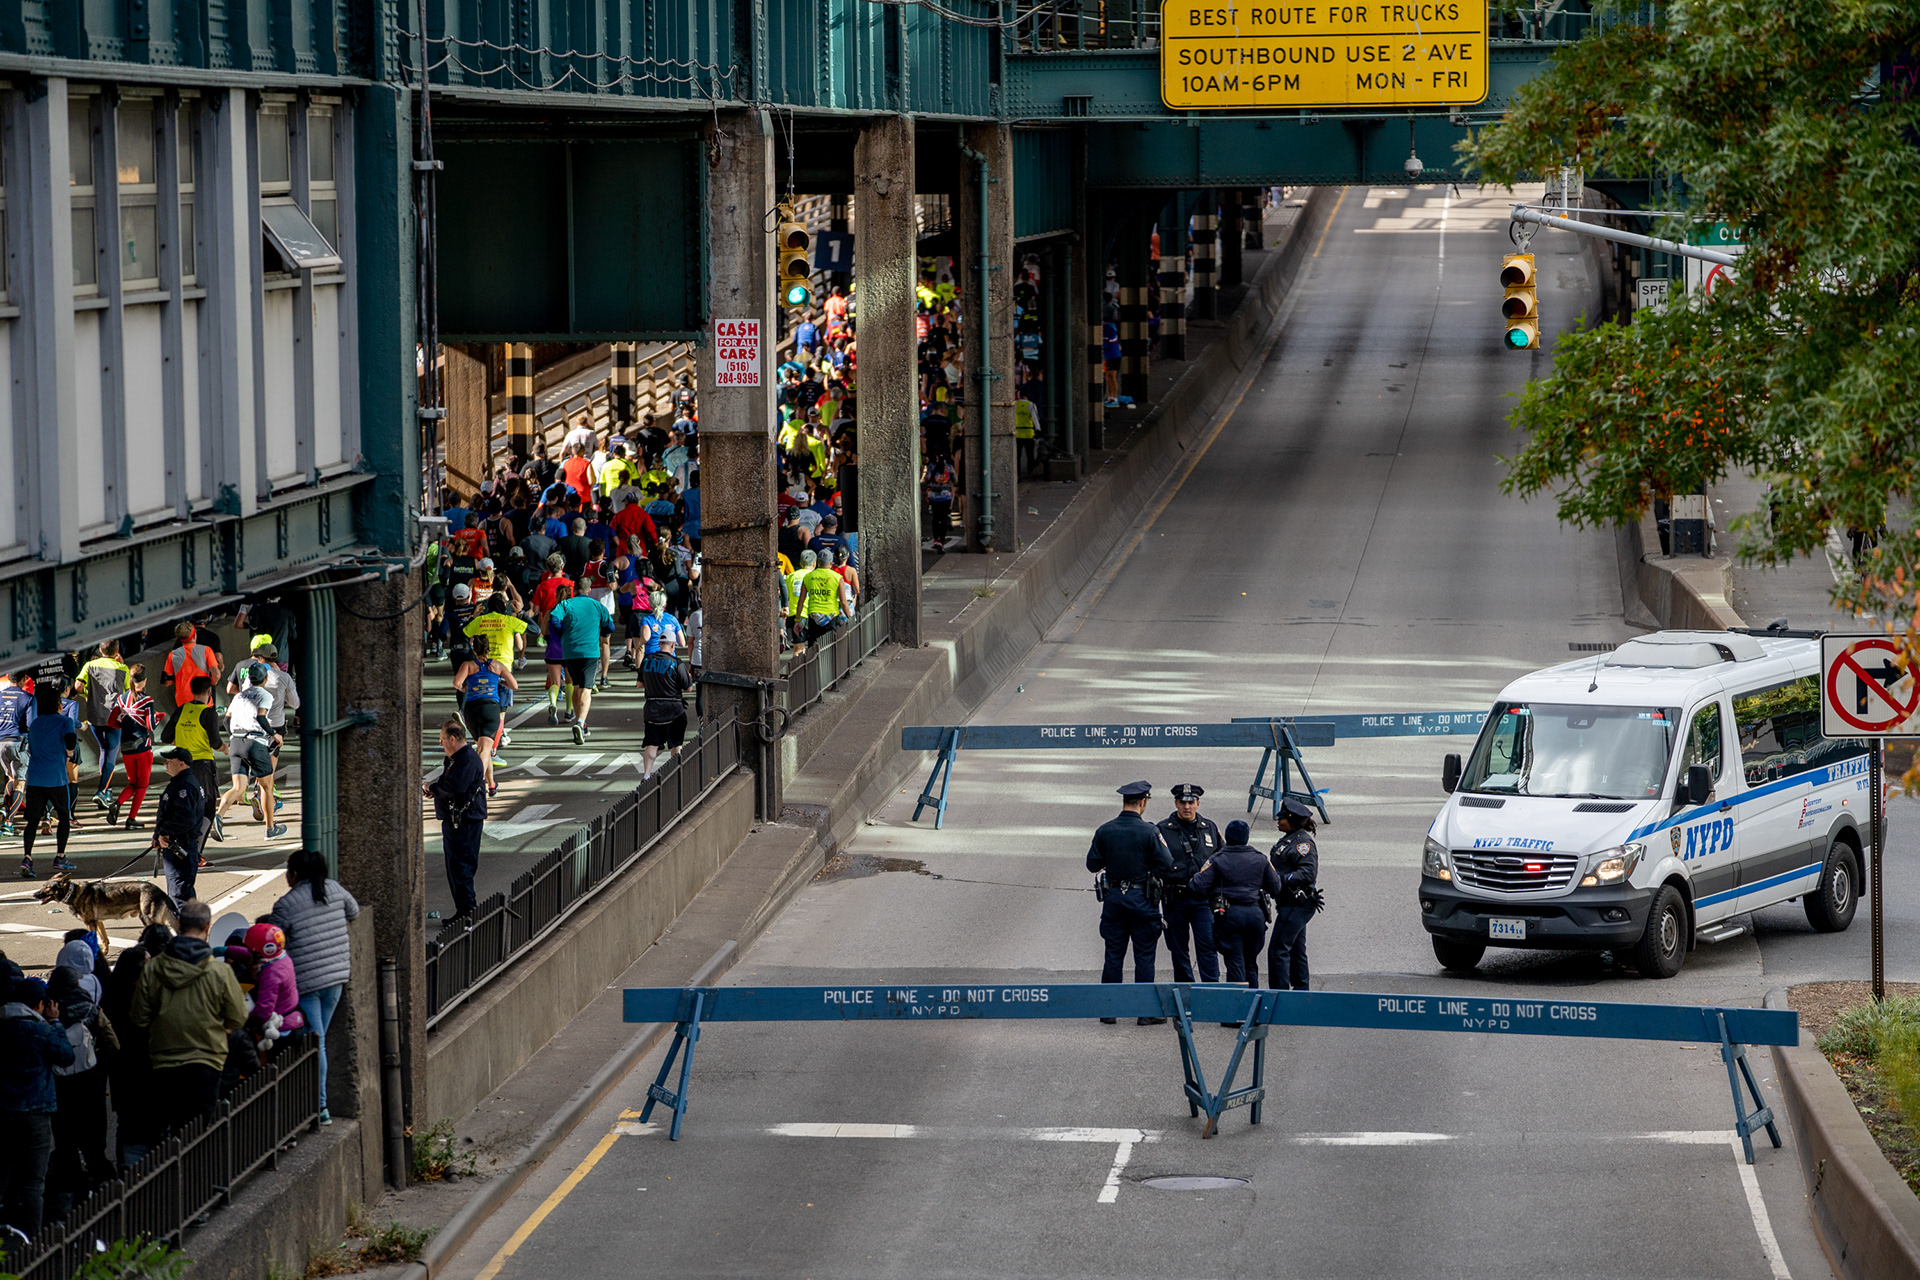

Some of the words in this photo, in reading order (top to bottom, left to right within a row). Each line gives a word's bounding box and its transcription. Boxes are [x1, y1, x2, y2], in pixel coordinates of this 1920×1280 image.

[1190, 9, 1238, 26] BEST
[1251, 8, 1316, 25] ROUTE
[1329, 6, 1367, 23] FOR
[1381, 4, 1459, 22] TRUCKS
[1178, 47, 1335, 65] SOUTHBOUND
[1347, 45, 1390, 62] USE
[1402, 44, 1415, 61] 2
[1427, 44, 1472, 61] AVE
[1182, 74, 1299, 92] 10AM-6PM
[1357, 72, 1405, 89] MON
[1433, 71, 1467, 88] FRI
[829, 240, 841, 262] 1
[1642, 285, 1666, 295] SPE
[717, 321, 758, 338] CA$H
[720, 347, 756, 361] CAR$
[726, 361, 749, 372] (516)
[718, 372, 758, 384] 284-9395
[810, 588, 831, 596] GUIDE
[1362, 716, 1394, 726] POLICE
[1402, 715, 1423, 725] LINE
[1438, 715, 1450, 725] DO
[1454, 714, 1472, 724] NOT
[1041, 727, 1076, 737] POLICE
[1085, 727, 1107, 737] LINE
[1124, 727, 1136, 736] DO
[1141, 727, 1160, 736] NOT
[1164, 726, 1198, 736] CROSS
[1474, 838, 1503, 848] NYPD
[1506, 837, 1554, 851] TRAFFIC
[1683, 817, 1734, 861] NYPD
[1492, 923, 1515, 934] 7314
[824, 990, 874, 1004] POLICE
[888, 990, 918, 1003] LINE
[943, 989, 960, 1002] DO
[968, 989, 995, 1002] NOT
[1002, 988, 1049, 1002] CROSS
[912, 1006, 960, 1015] NYPD
[1378, 998, 1426, 1014] POLICE
[1439, 1001, 1468, 1015] LINE
[1492, 1003, 1509, 1017] DO
[1516, 1004, 1544, 1018] NOT
[1550, 1005, 1596, 1020] CROSS
[1463, 1018, 1510, 1029] NYPD
[1226, 1095, 1245, 1109] POLICE
[1246, 1090, 1260, 1103] DEPT
